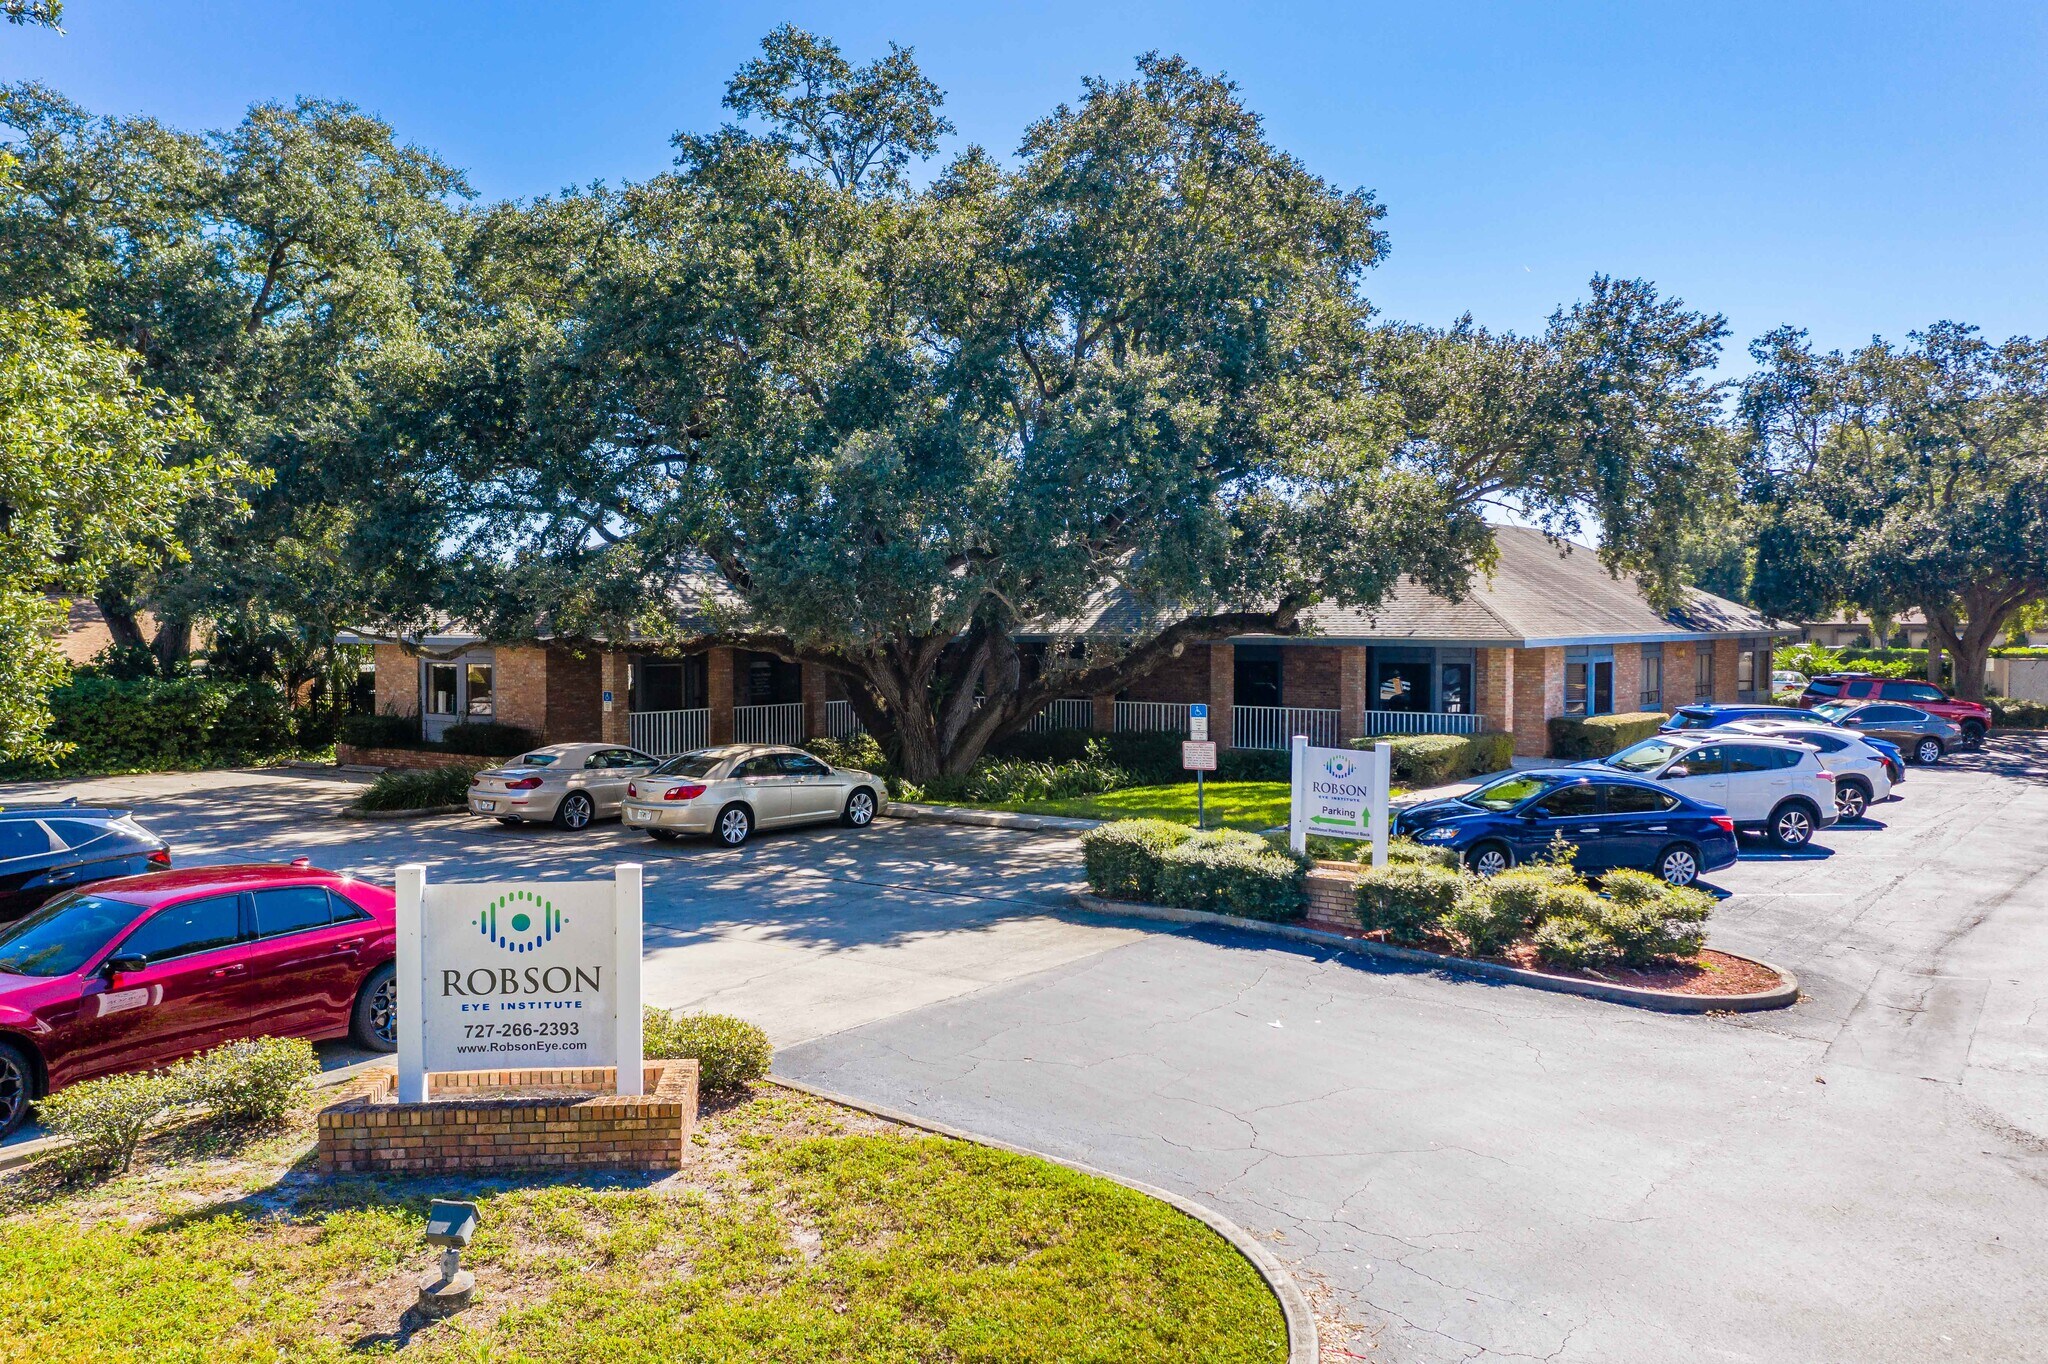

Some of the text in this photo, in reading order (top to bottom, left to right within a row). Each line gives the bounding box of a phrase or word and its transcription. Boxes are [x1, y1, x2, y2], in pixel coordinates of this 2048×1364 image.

[1313, 781, 1367, 797] ROBSON
[1322, 806, 1356, 819] Parking
[441, 966, 602, 997] ROBSON
[461, 1001, 582, 1011] EYE INSTITUTE
[464, 1022, 579, 1039] 727-266-2393
[457, 1041, 587, 1054] www.RobsonEye.com
